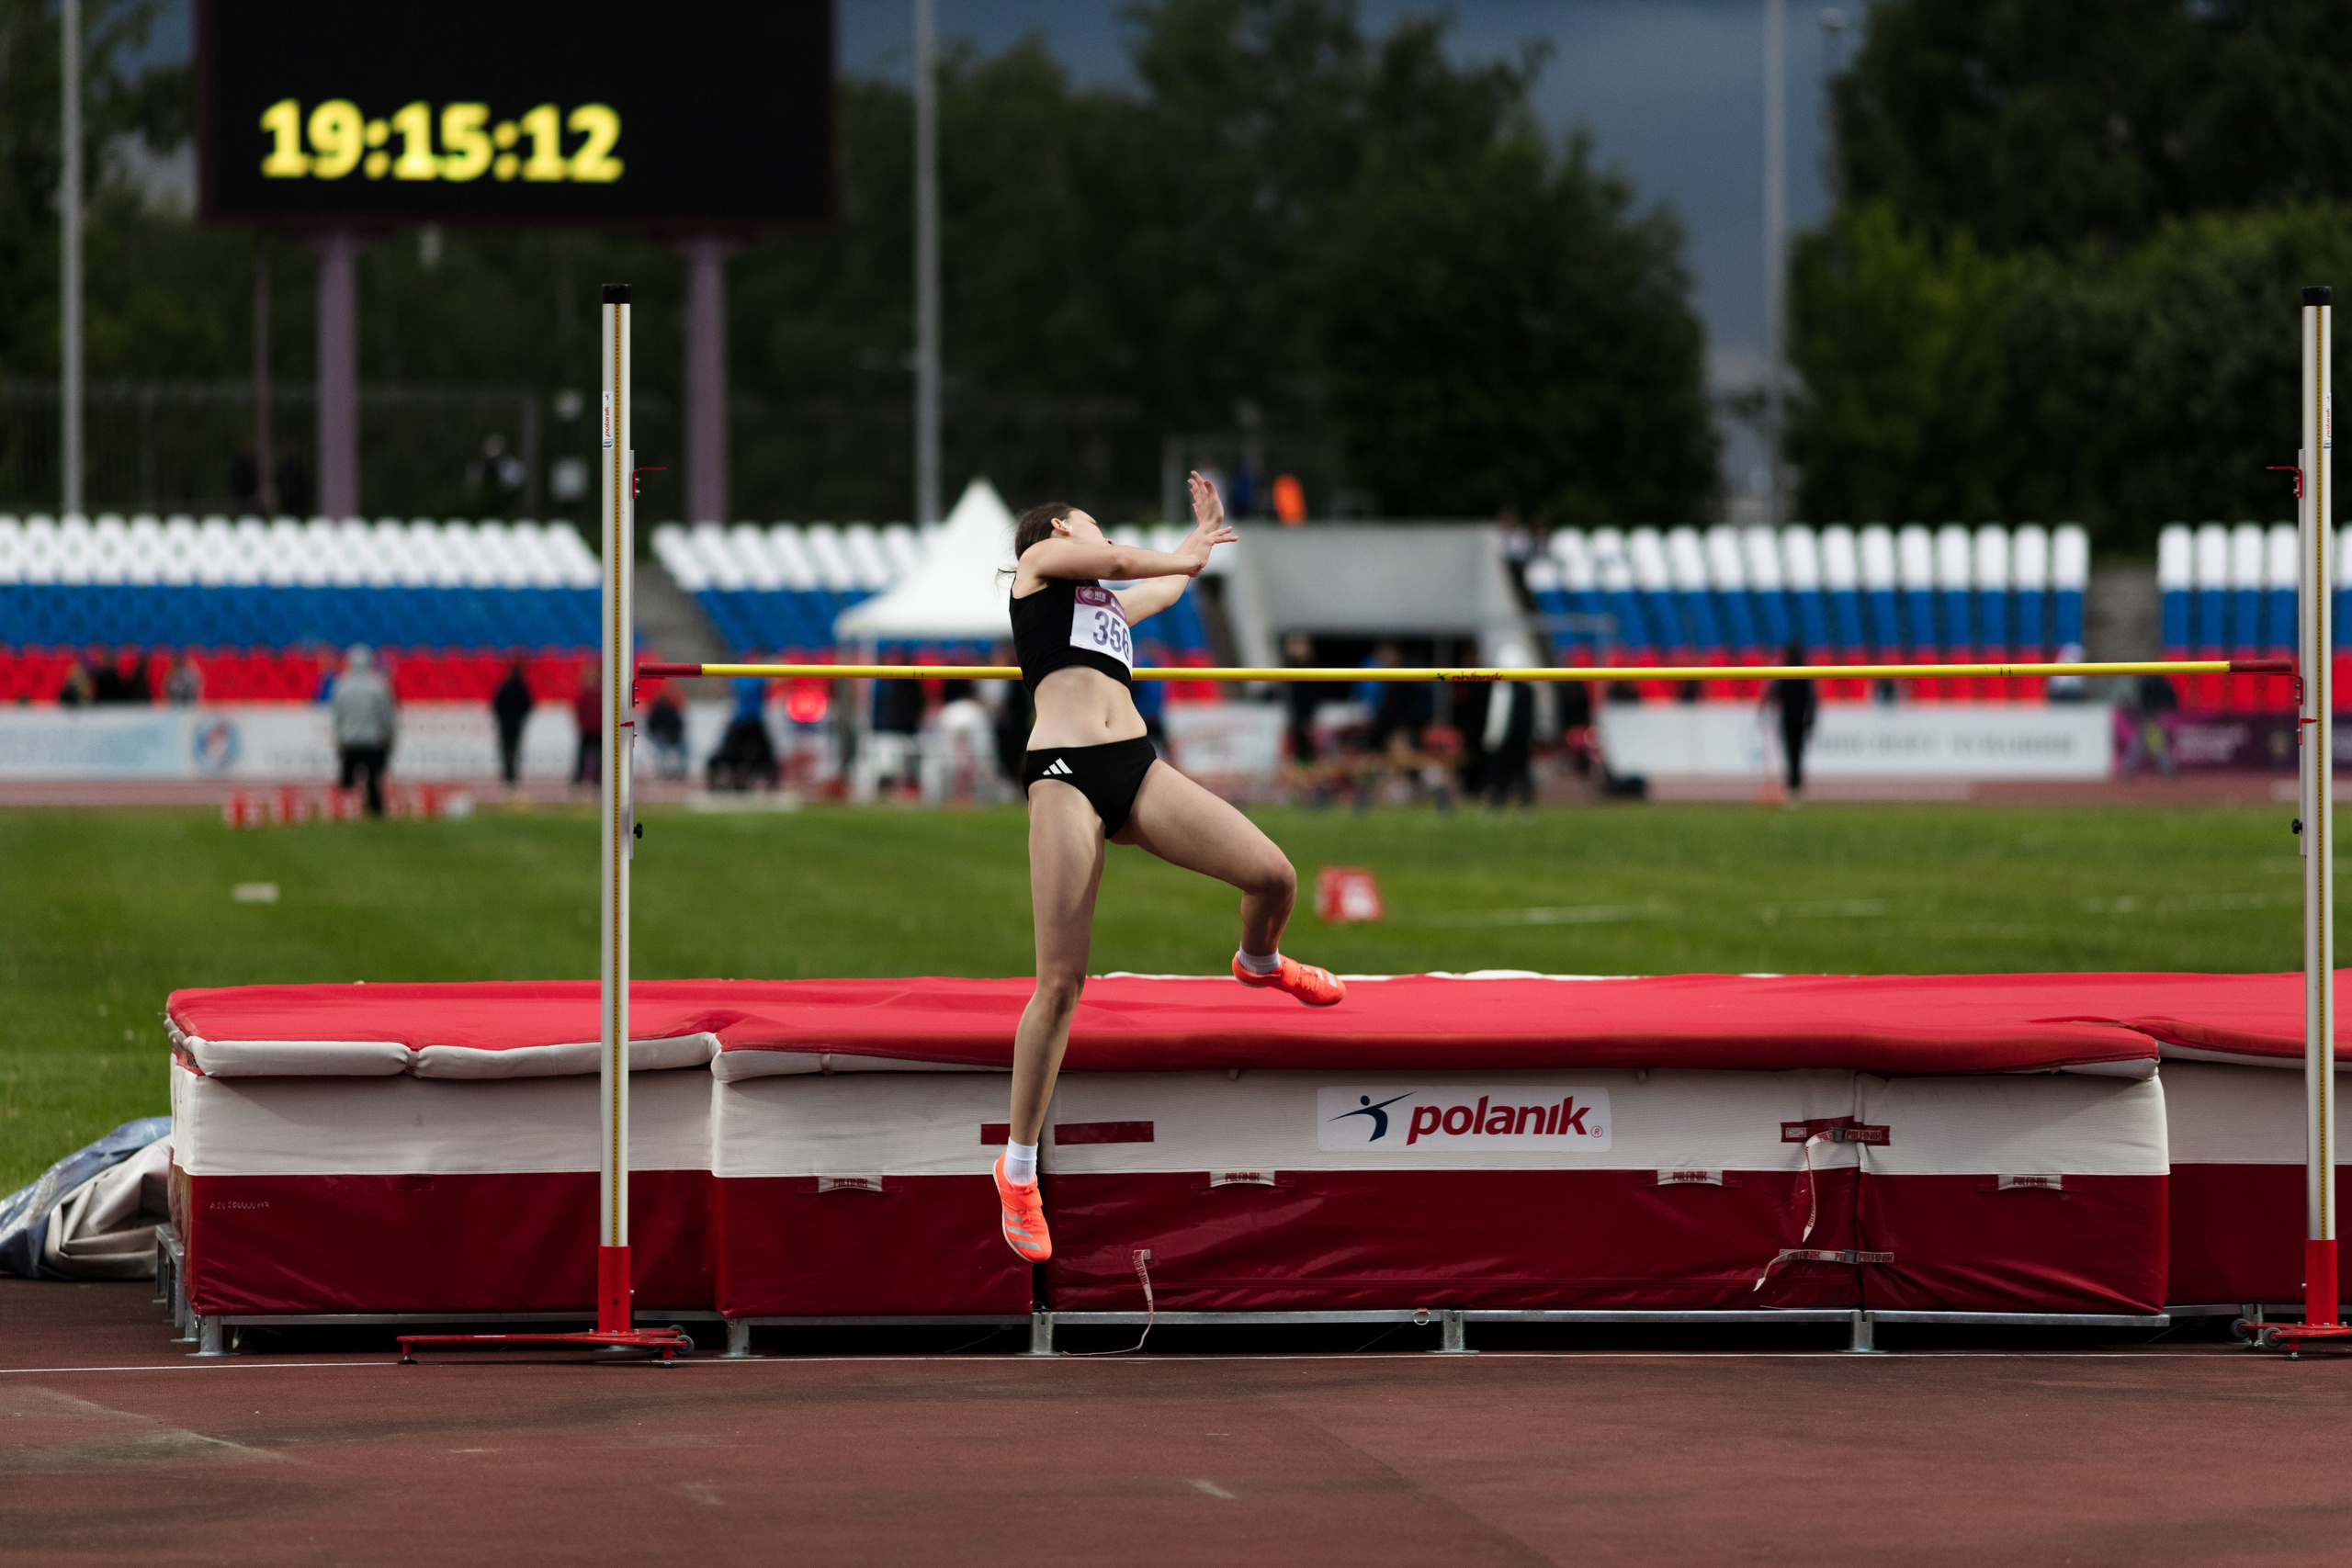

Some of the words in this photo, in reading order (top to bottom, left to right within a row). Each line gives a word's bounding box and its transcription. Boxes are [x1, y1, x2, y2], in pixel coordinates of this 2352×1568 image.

[261, 98, 624, 182] 19:15:12
[1093, 611, 1129, 661] 356
[1406, 1095, 1590, 1145] polanik
